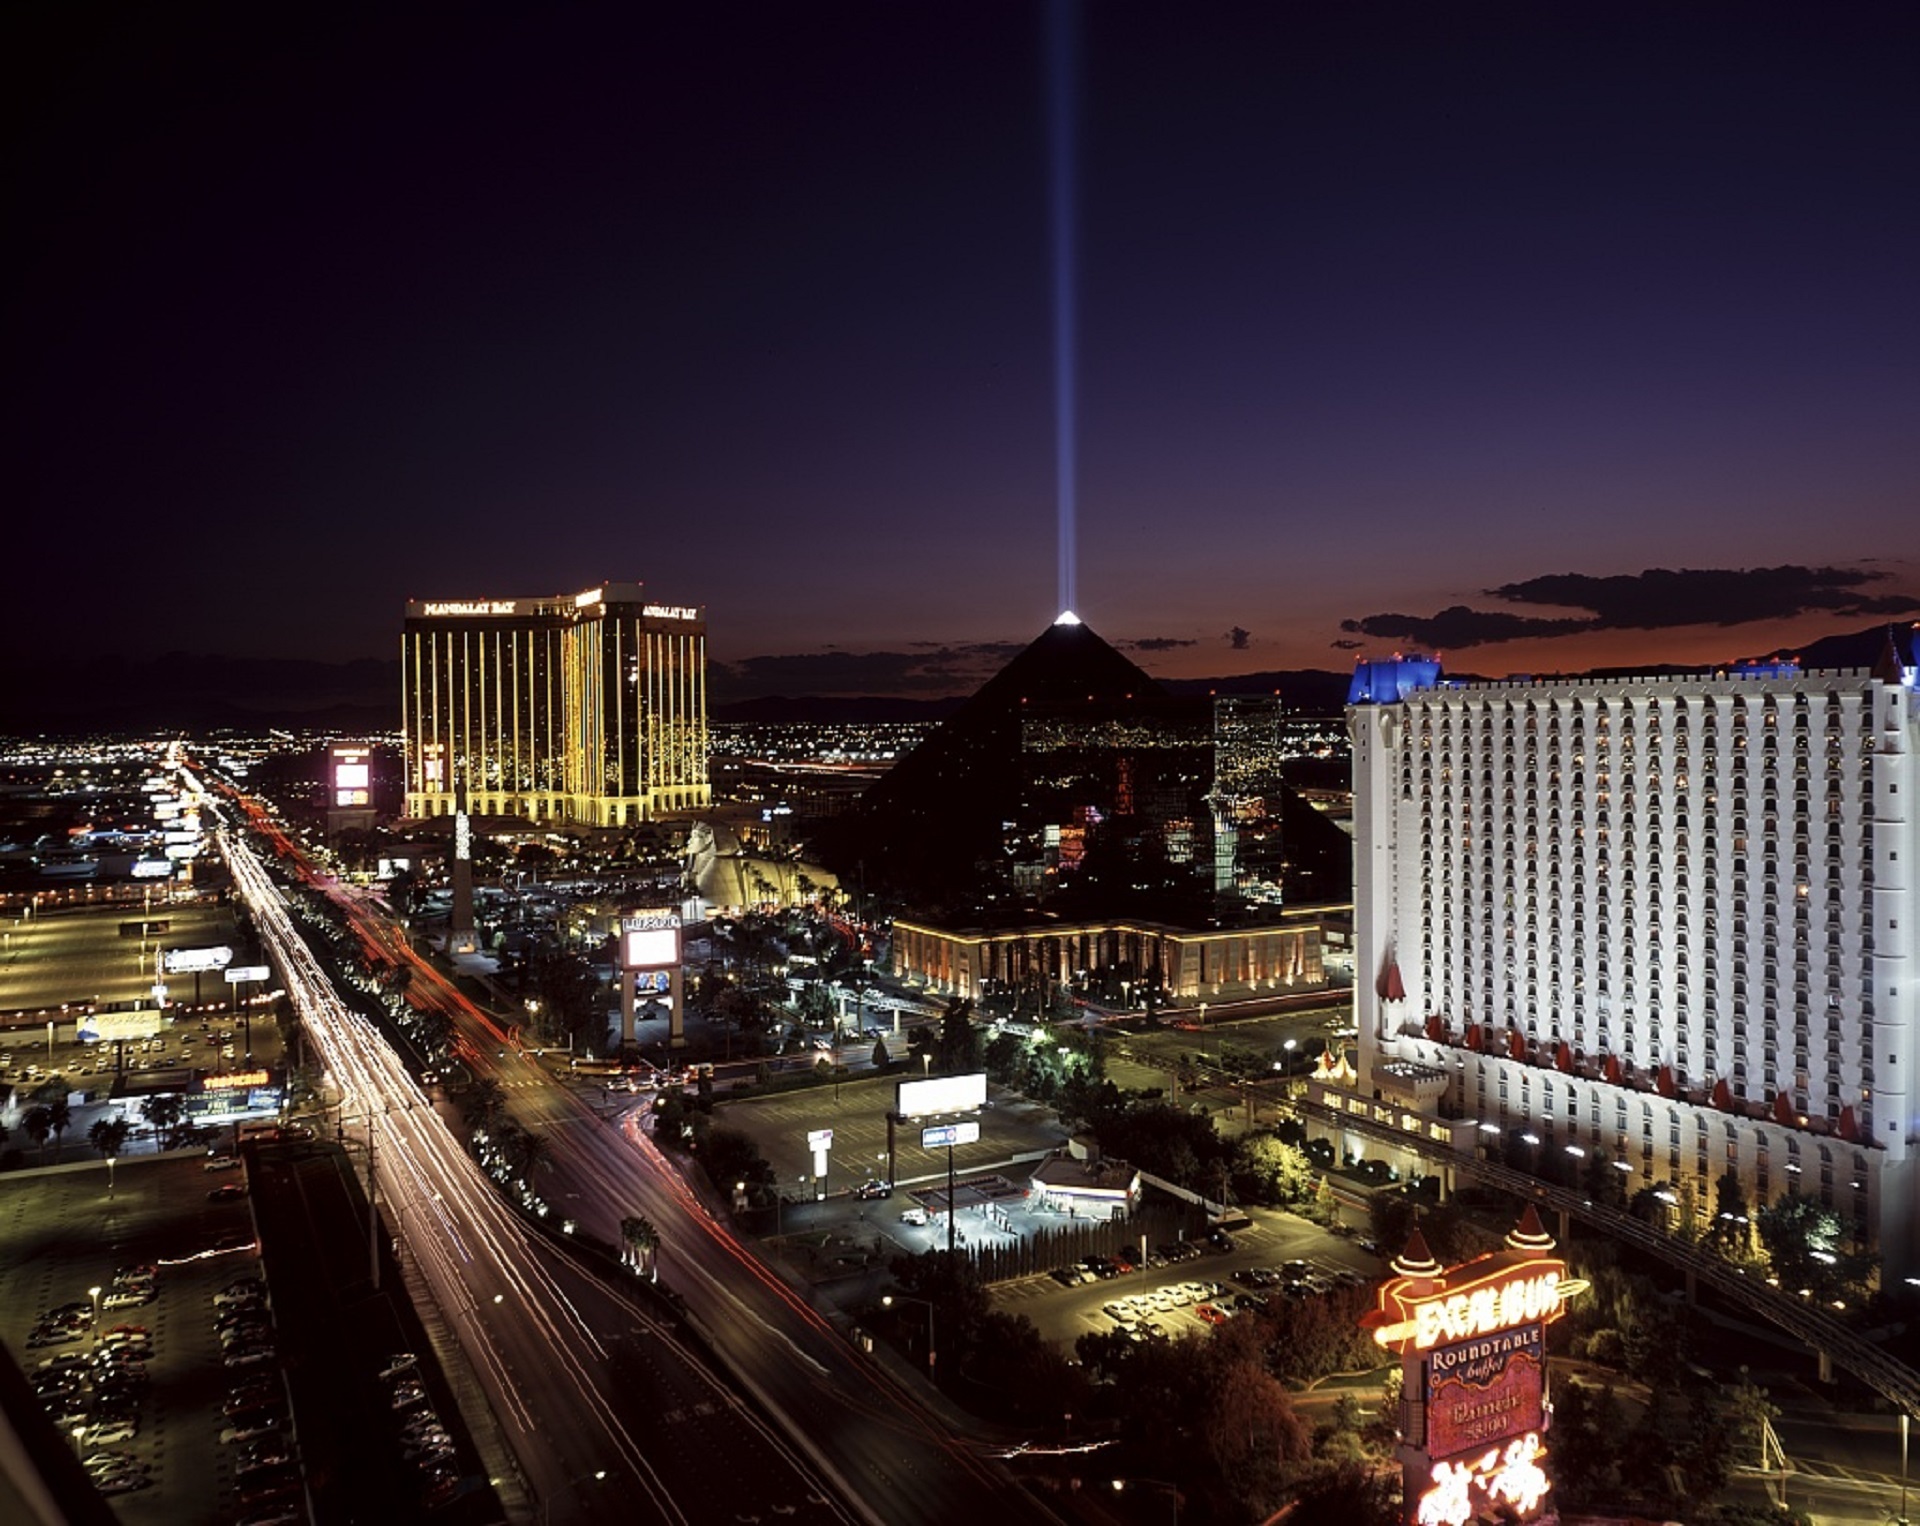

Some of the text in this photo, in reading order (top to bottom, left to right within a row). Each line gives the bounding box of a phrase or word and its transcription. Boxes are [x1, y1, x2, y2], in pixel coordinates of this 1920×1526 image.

[424, 602, 516, 616] MANDALAY BAY
[1415, 1271, 1560, 1349] EXCALIBUR
